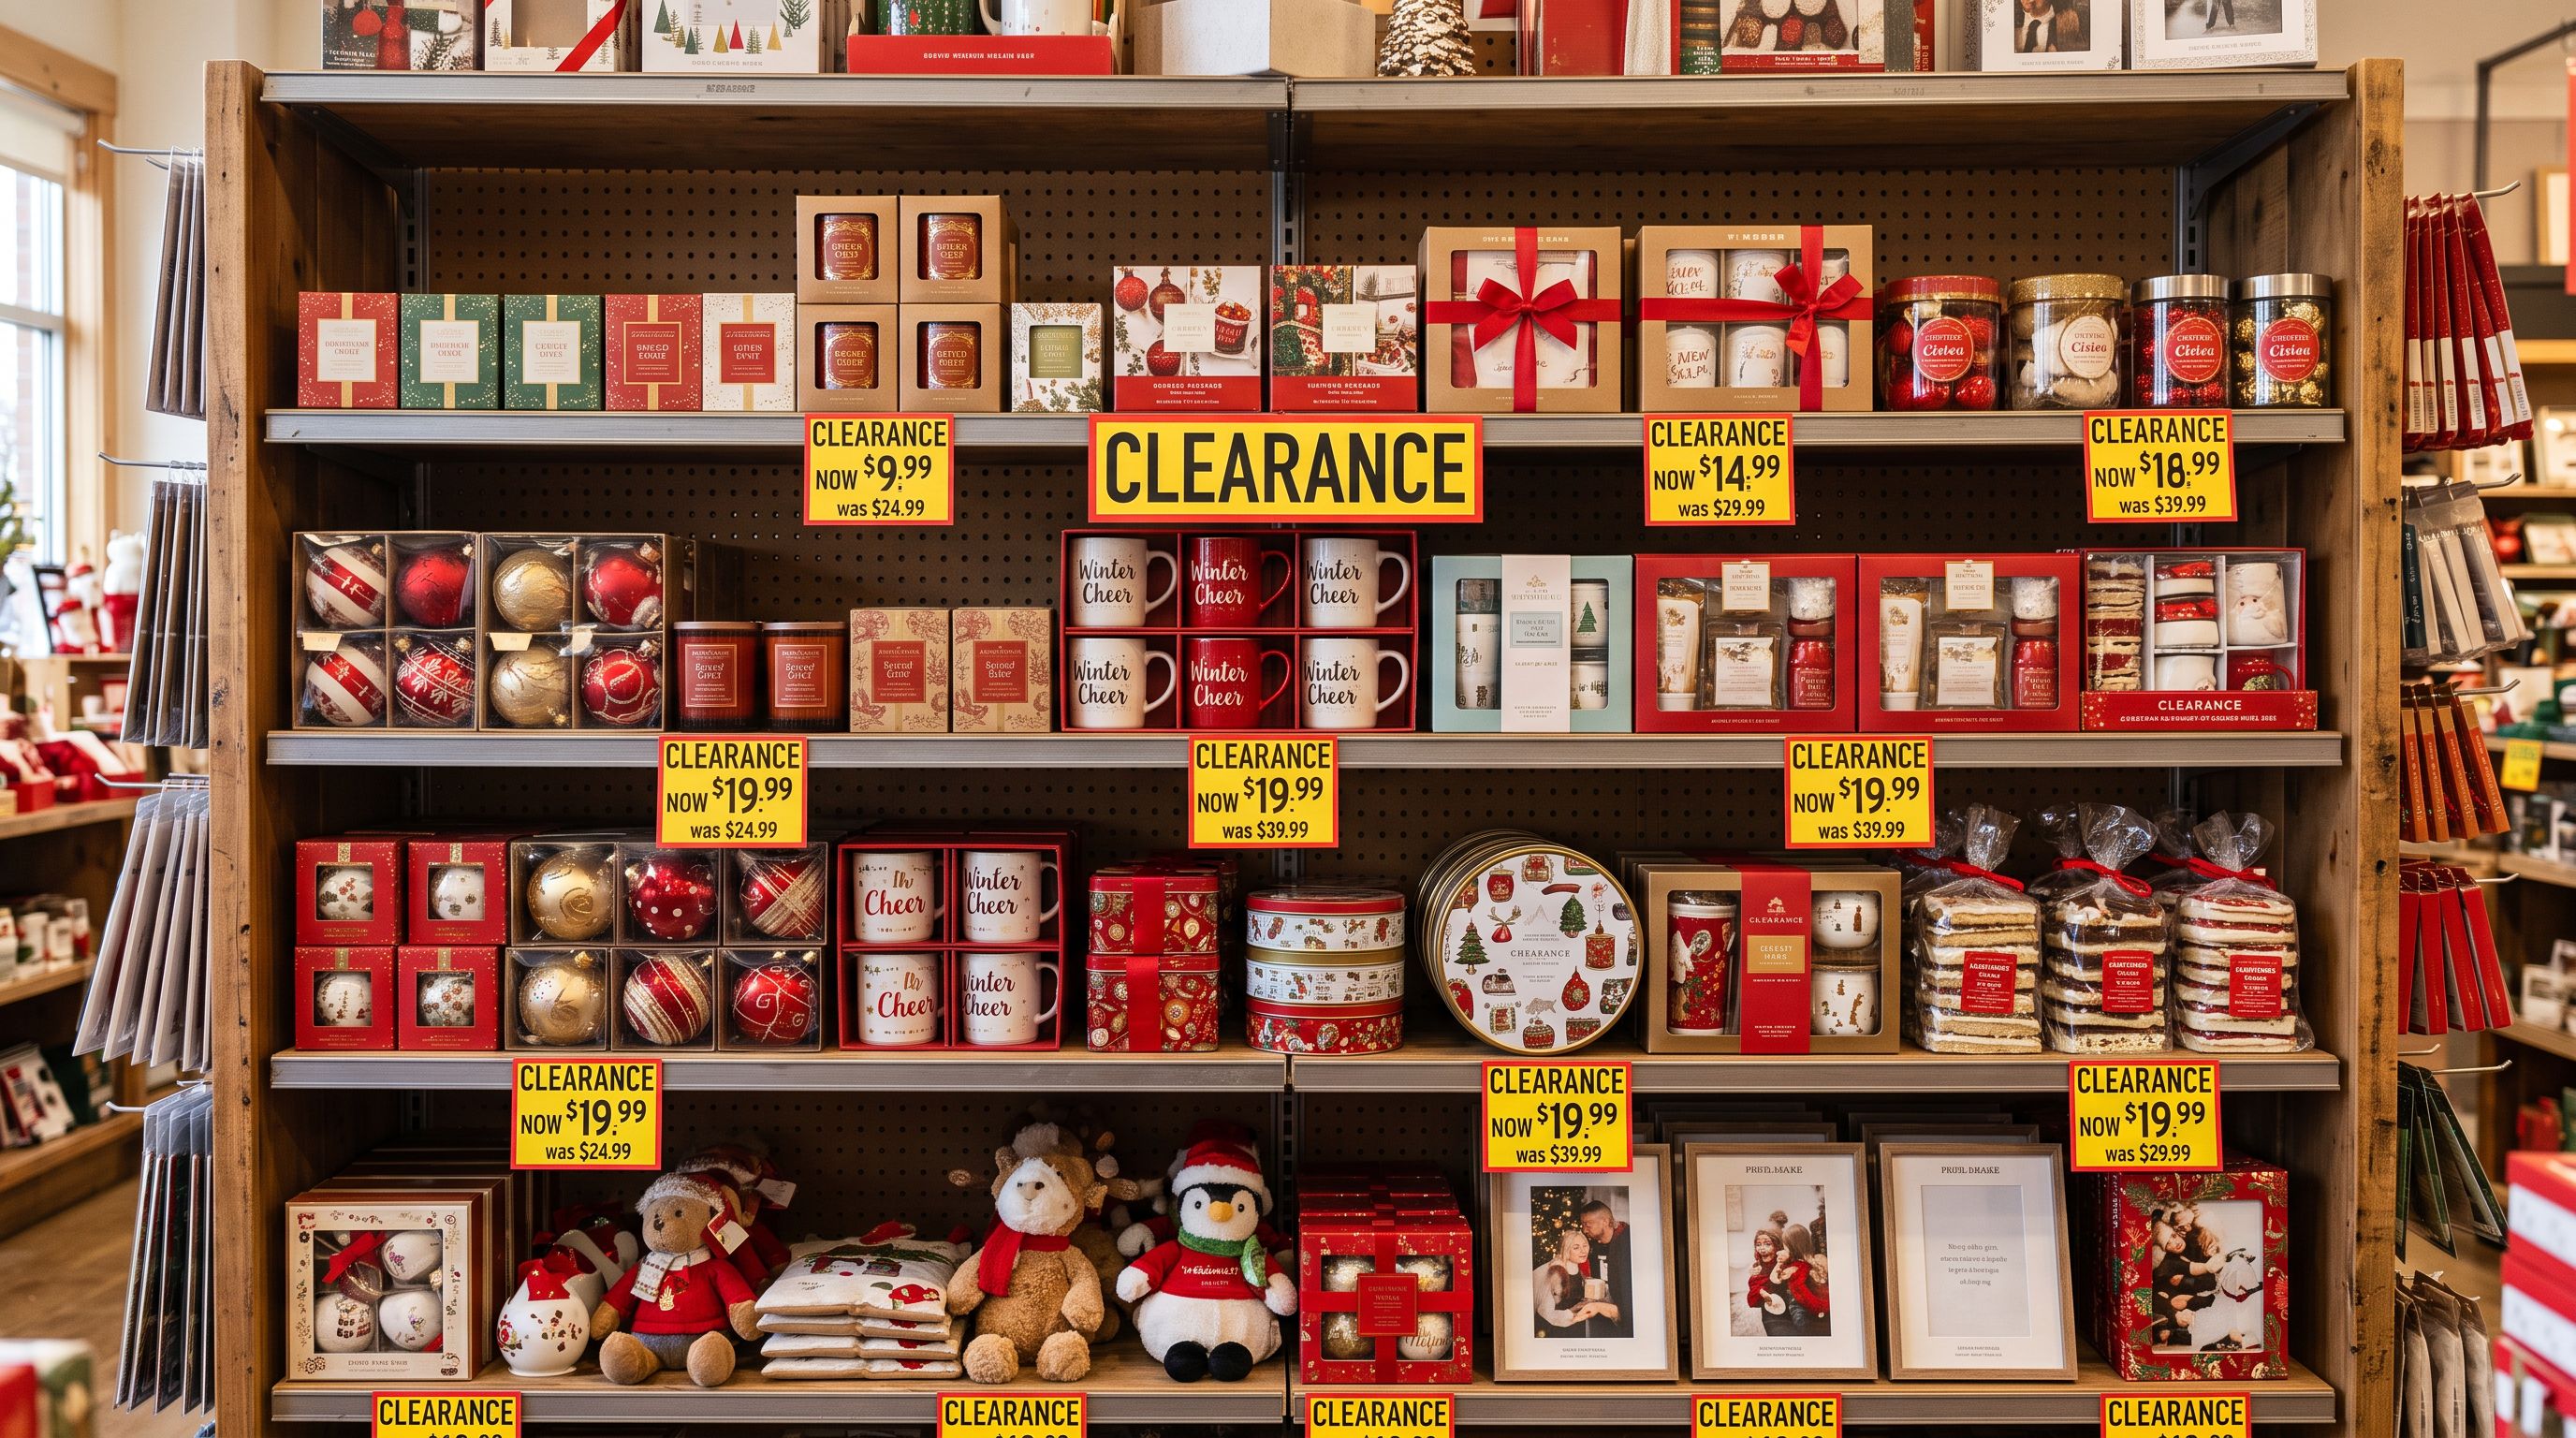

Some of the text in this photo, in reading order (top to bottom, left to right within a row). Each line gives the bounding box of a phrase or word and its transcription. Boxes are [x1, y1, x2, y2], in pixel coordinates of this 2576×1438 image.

[812, 420, 946, 448] CLEARANCE
[1651, 420, 1786, 448] CLEARANCE
[2091, 417, 2226, 444] CLEARANCE
[1105, 432, 1466, 504] CLEARANCE
[2095, 467, 2136, 488] NOW
[815, 469, 858, 491] NOW
[1654, 469, 1695, 491] NOW
[837, 497, 925, 519] was $24.99
[1677, 498, 1765, 519] was $29.99
[2118, 494, 2206, 515] was $39.99
[1079, 559, 1135, 580] Winter
[1191, 559, 1249, 581] Winter
[1307, 559, 1361, 580] Winter
[1083, 583, 1134, 605] Cheer
[1194, 583, 1245, 606] Cheer
[1310, 583, 1359, 606] Cheer
[1074, 660, 1131, 682] Winter
[1191, 660, 1248, 683] Winter
[1303, 660, 1360, 682] Winter
[1078, 683, 1128, 705] Cheer
[1193, 683, 1244, 707] Cheer
[1308, 683, 1356, 705] Cheer
[2158, 699, 2242, 711] CLEARANCE
[666, 742, 800, 770] CLEARANCE
[1196, 742, 1330, 770] CLEARANCE
[1793, 742, 1926, 770] CLEARANCE
[666, 792, 709, 813] NOW
[1197, 792, 1239, 814] NOW
[1793, 792, 1836, 814] NOW
[690, 820, 778, 840] was $24.99
[1222, 820, 1309, 840] was $39.99
[1818, 820, 1905, 840] was $39.99
[964, 866, 1021, 890] Winter
[865, 889, 926, 916] Cheer
[967, 891, 1017, 915] Cheer
[878, 991, 934, 1019] Cheer
[962, 993, 1012, 1017] Cheer
[520, 1064, 654, 1092] CLEARANCE
[1490, 1067, 1624, 1094] CLEARANCE
[2077, 1066, 2212, 1094] CLEARANCE
[520, 1114, 563, 1135] NOW
[1491, 1117, 1533, 1138] NOW
[2080, 1116, 2121, 1137] NOW
[545, 1140, 631, 1163] was $24.99
[1515, 1143, 1602, 1166] was $39.99
[2105, 1142, 2191, 1164] was $29.99
[379, 1399, 514, 1426] CLEARANCE
[944, 1400, 1079, 1427] CLEARANCE
[1313, 1401, 1447, 1427] CLEARANCE
[1699, 1401, 1834, 1428] CLEARANCE
[2108, 1399, 2244, 1427] CLEARANCE
